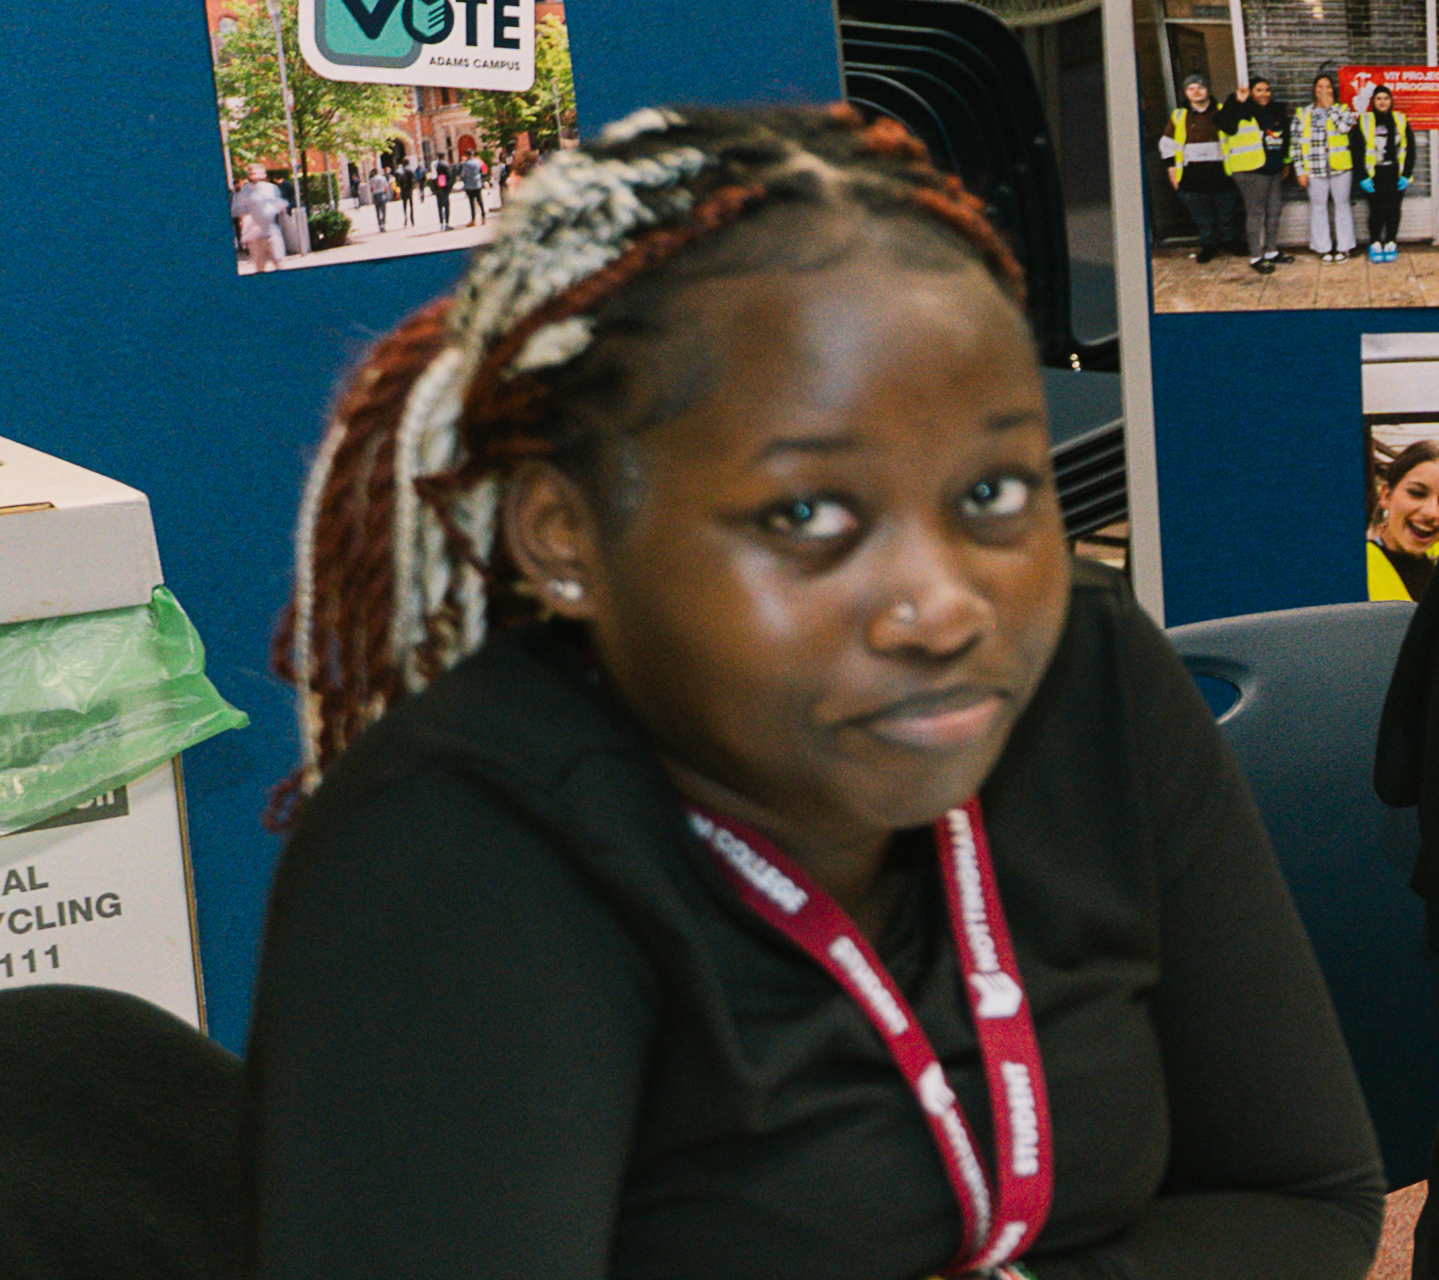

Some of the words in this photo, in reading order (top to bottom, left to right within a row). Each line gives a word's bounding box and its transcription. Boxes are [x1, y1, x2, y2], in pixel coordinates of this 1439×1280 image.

[429, 56, 470, 68] ADAMS
[474, 58, 521, 71] CAMPUS
[0, 892, 122, 935] CLING
